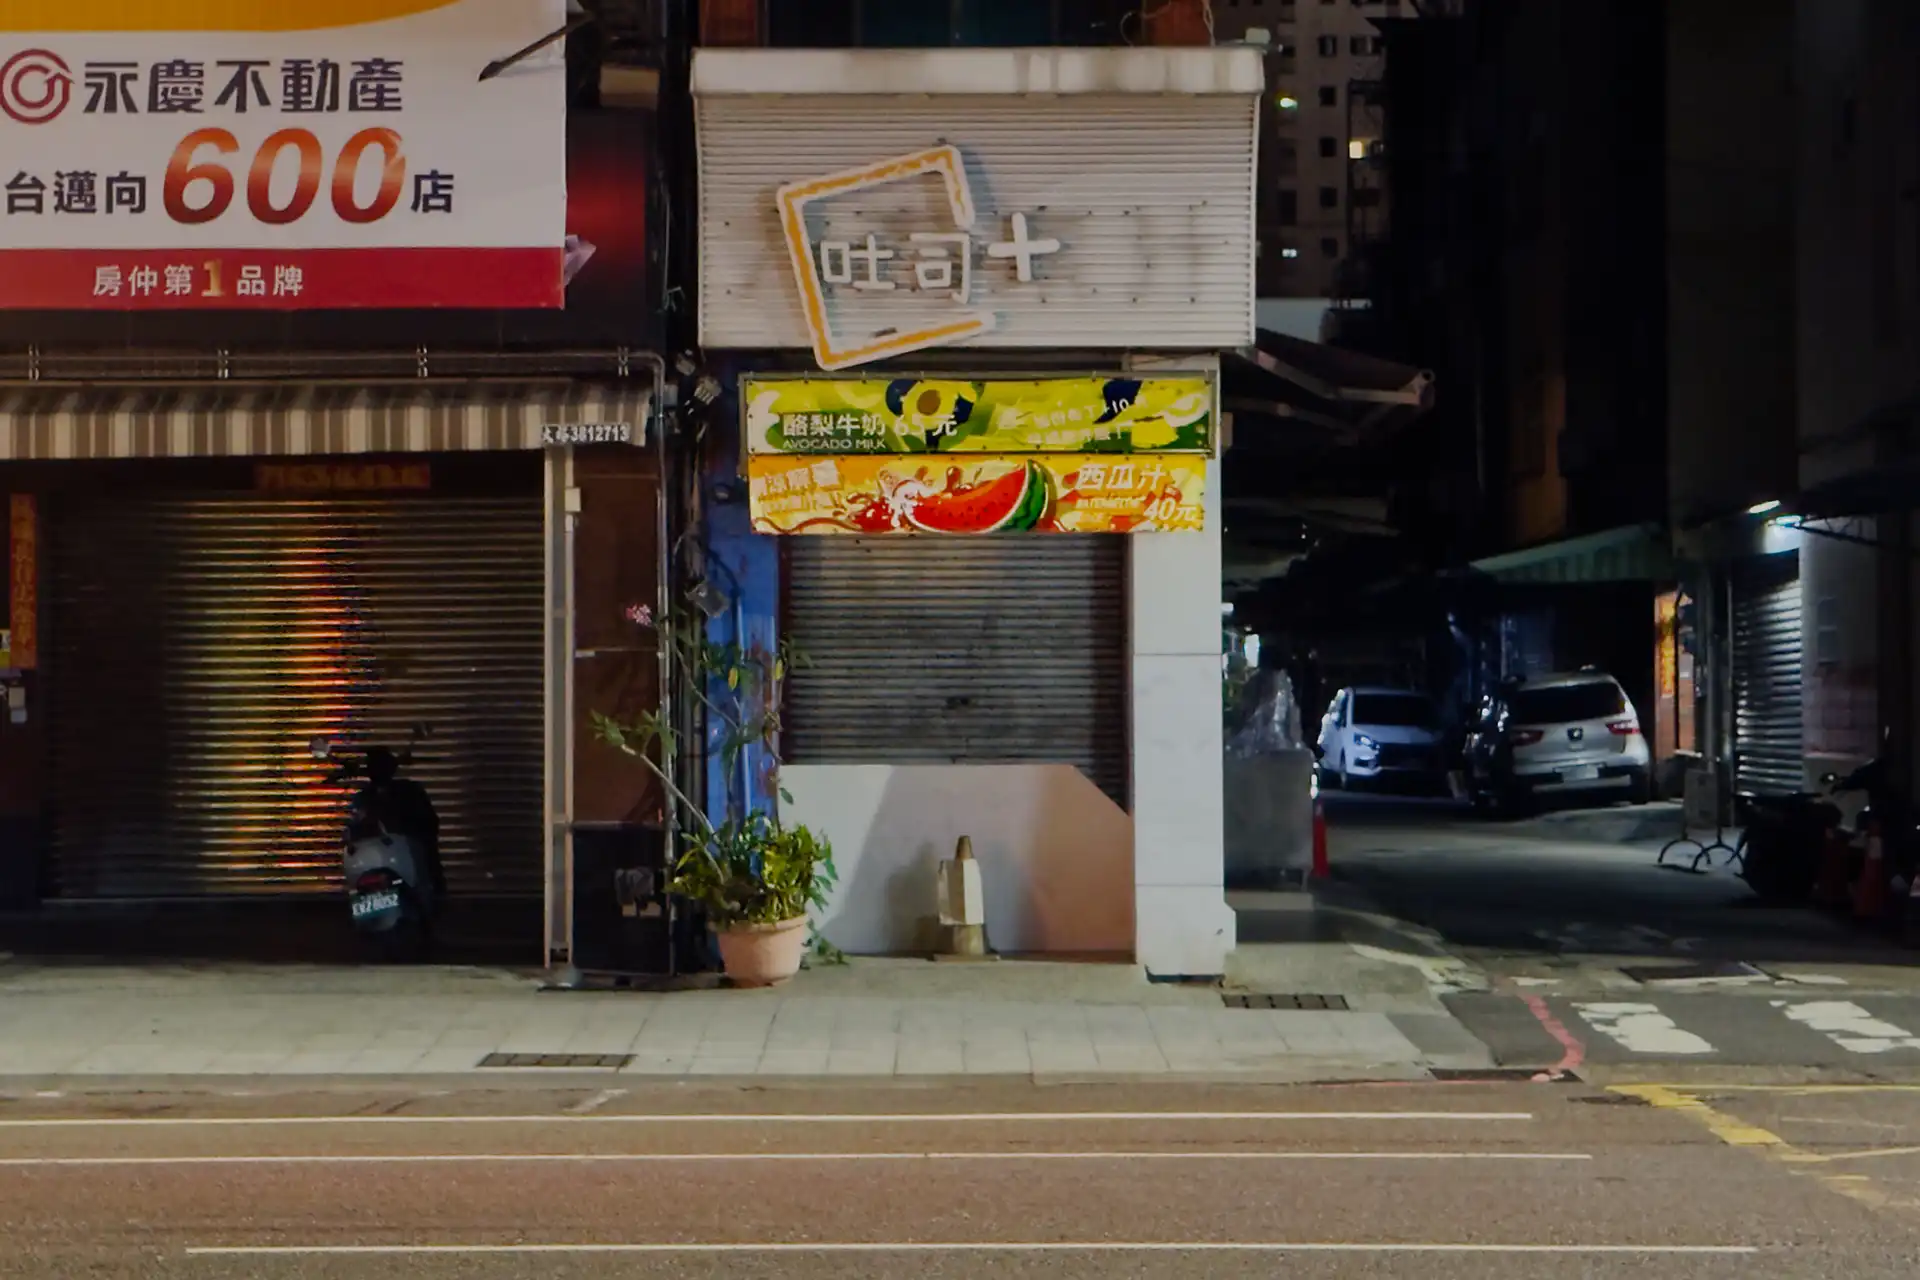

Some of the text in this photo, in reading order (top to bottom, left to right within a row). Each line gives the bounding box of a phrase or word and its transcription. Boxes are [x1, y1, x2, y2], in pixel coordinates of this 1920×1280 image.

[82, 58, 404, 113] 永慶不動產
[93, 258, 304, 298] 房仲第1品牌
[782, 413, 886, 437] 酪梨牛奶
[782, 438, 887, 450] AVOCADO MILK
[1074, 464, 1168, 490] 西瓜汁
[1143, 498, 1197, 522] 40元
